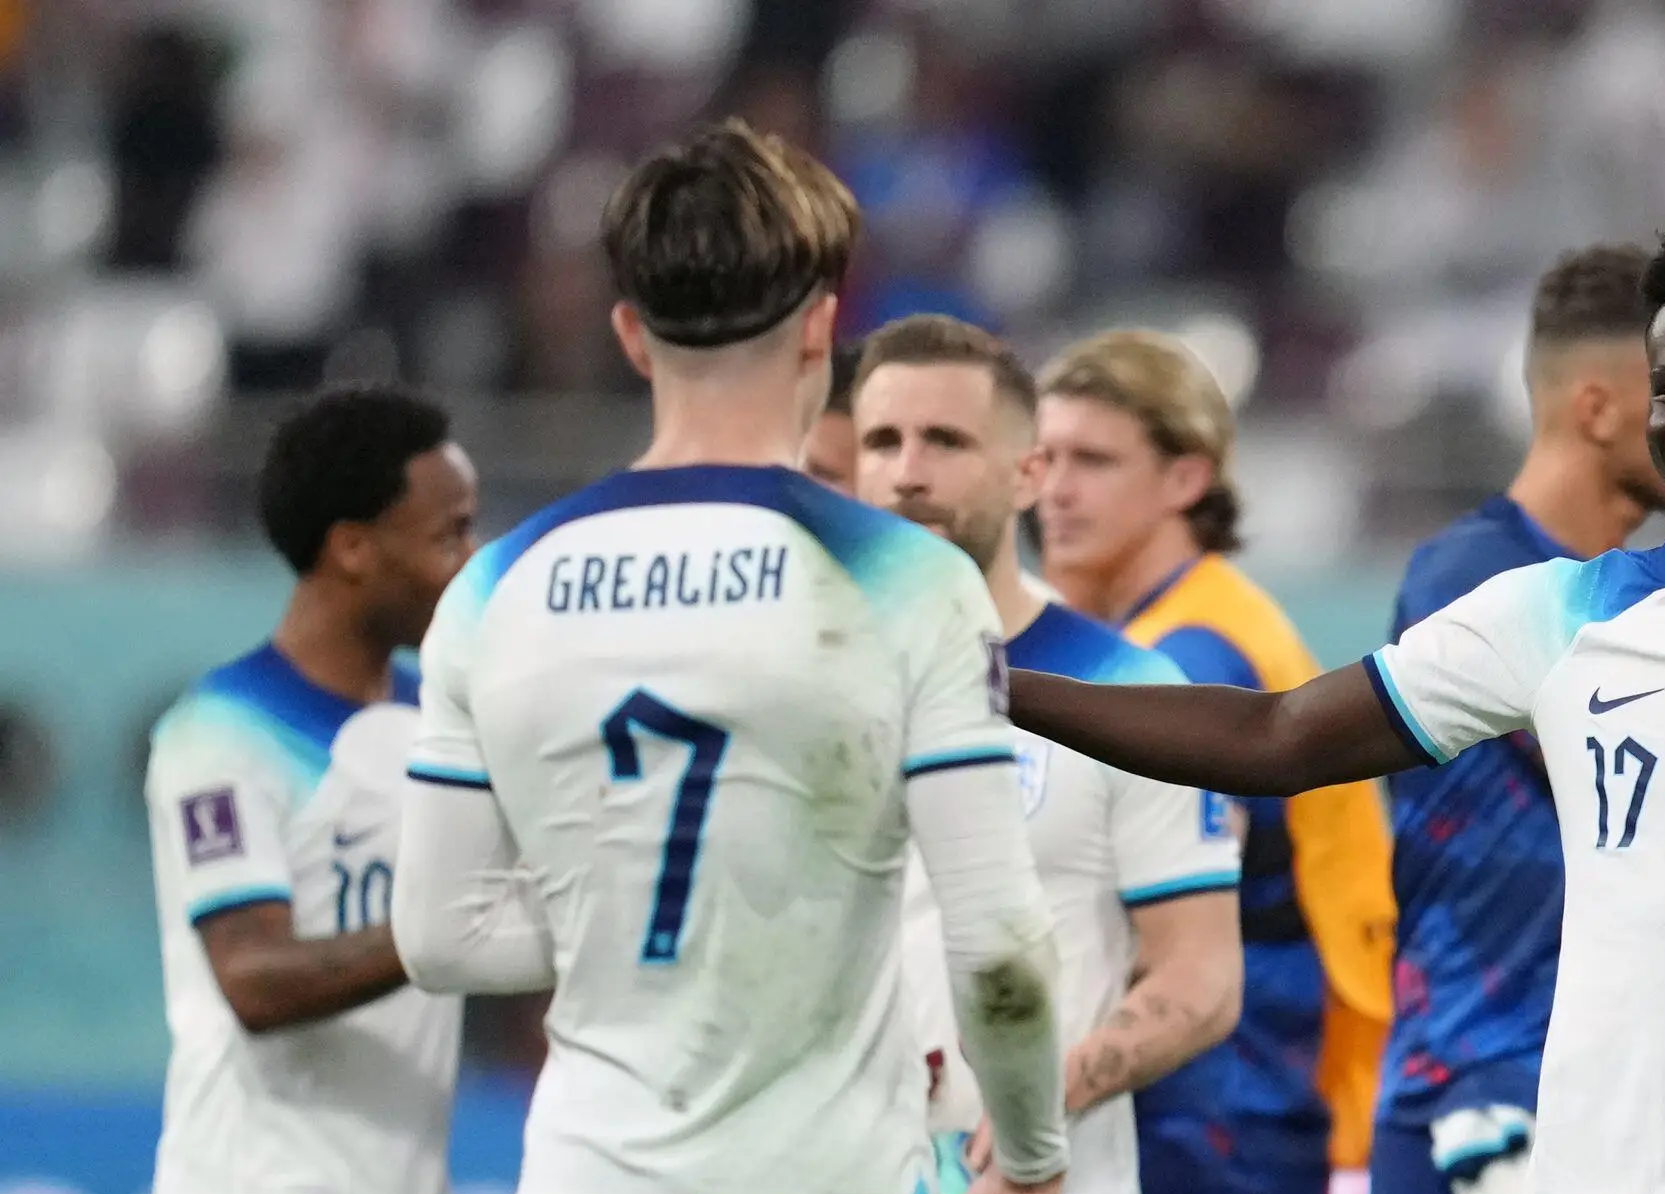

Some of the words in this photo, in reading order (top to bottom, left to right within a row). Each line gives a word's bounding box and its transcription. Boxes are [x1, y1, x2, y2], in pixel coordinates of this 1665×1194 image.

[599, 684, 732, 966] 7
[1586, 735, 1659, 849] 17
[331, 858, 394, 934] 10
